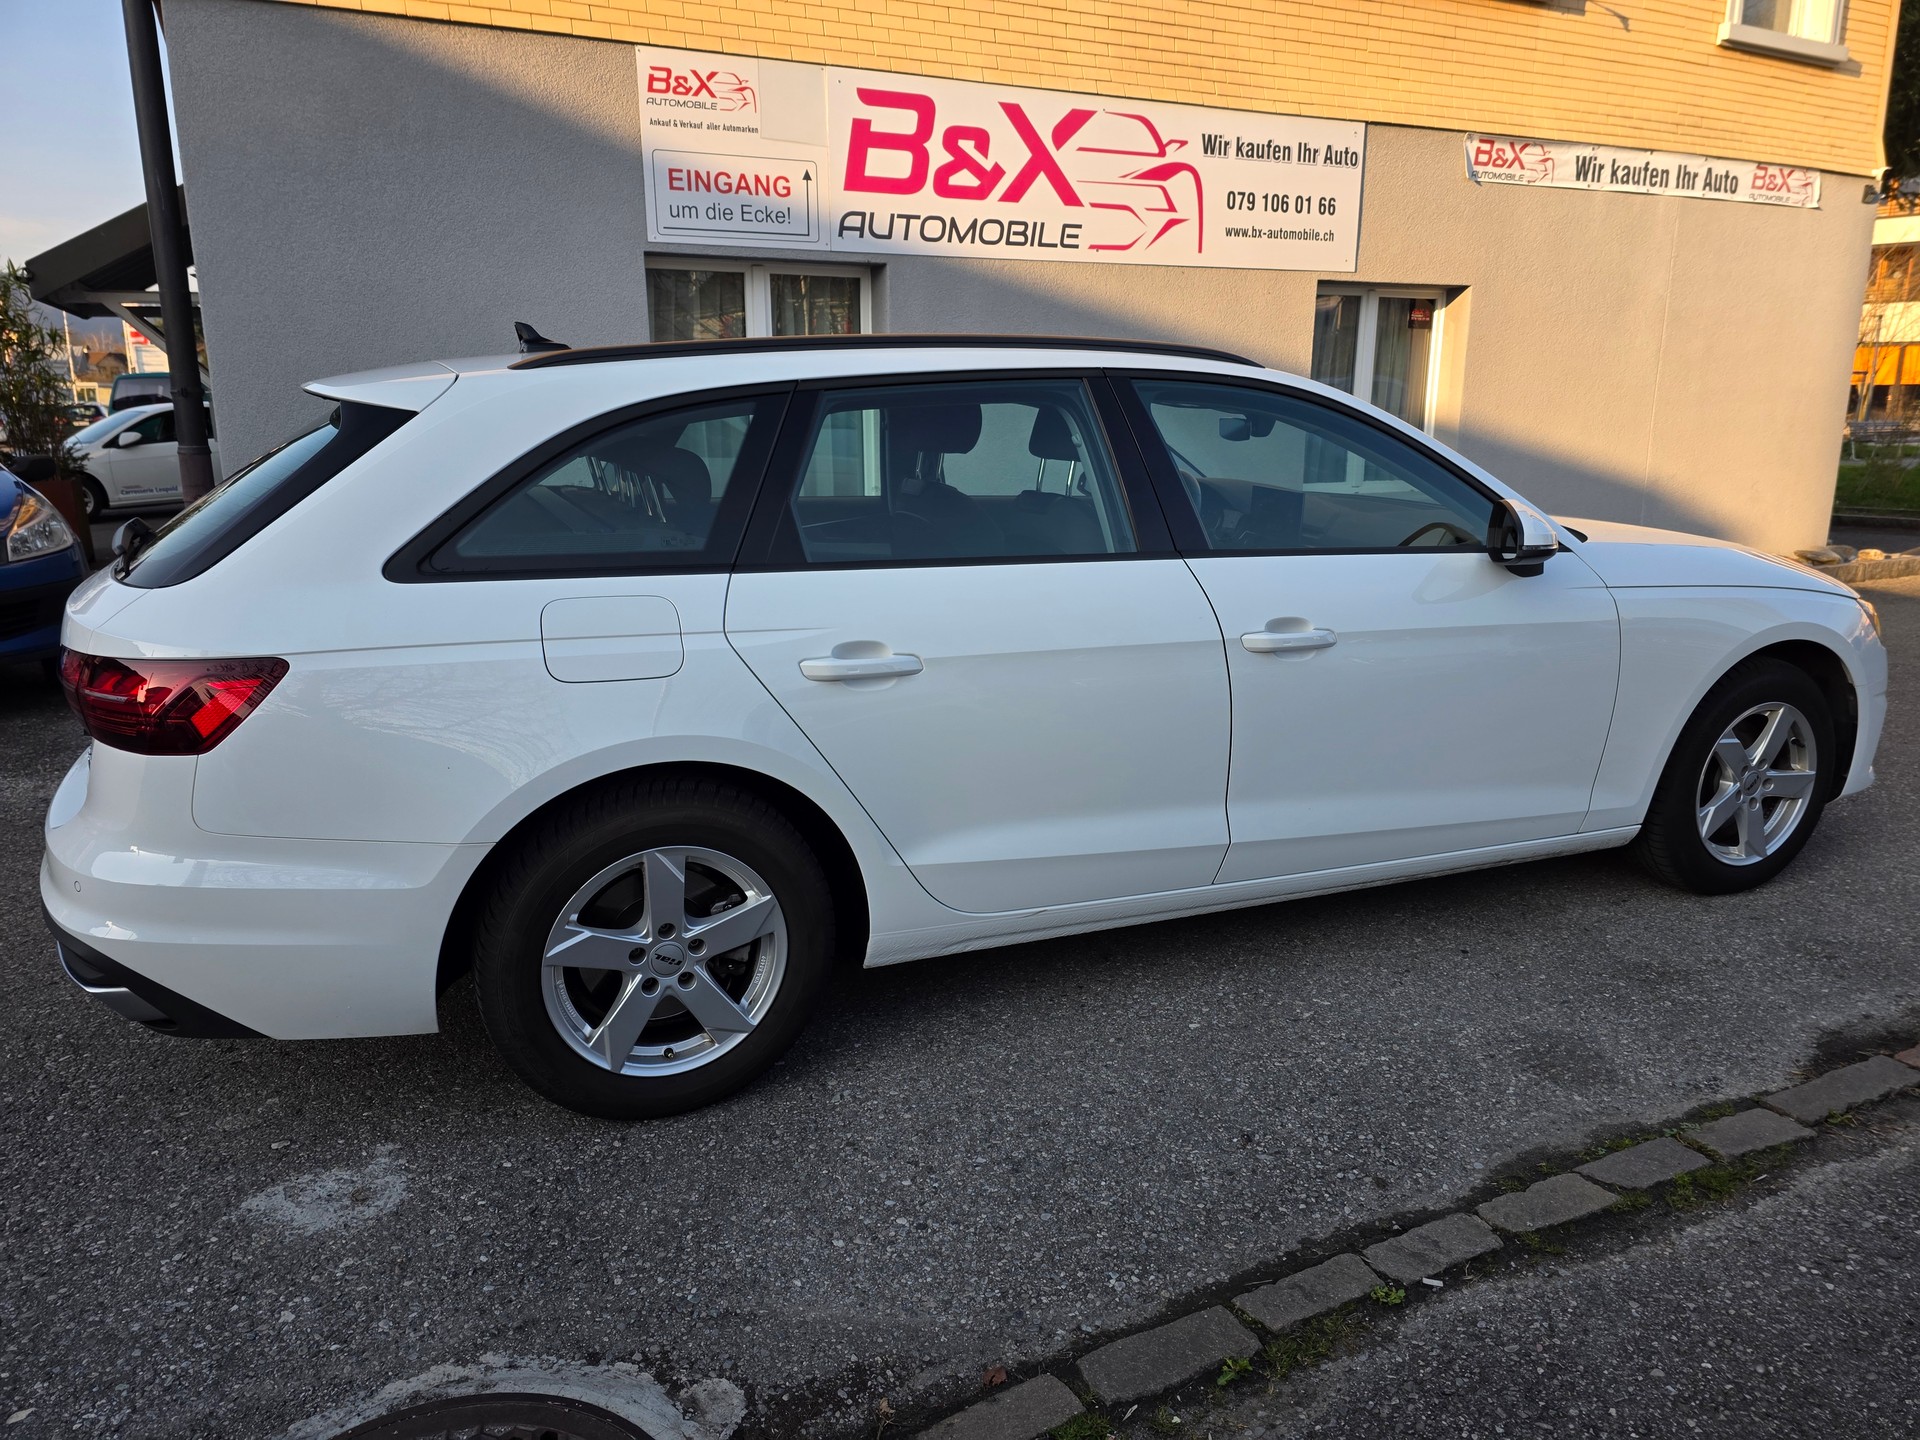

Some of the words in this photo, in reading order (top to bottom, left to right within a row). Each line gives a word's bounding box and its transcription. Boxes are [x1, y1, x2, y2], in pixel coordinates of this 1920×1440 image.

[647, 66, 719, 98] B&X
[646, 97, 717, 110] AUTOMOBILE
[650, 118, 671, 127] Ankauf
[680, 120, 703, 129] Verkauf
[706, 122, 720, 131] aller
[722, 123, 759, 133] Automarken
[843, 87, 1098, 207] B&X
[1202, 133, 1230, 157] Wir
[1235, 136, 1291, 162] kaufen
[1297, 142, 1319, 164] Ihr
[1323, 144, 1358, 167] Auto
[1473, 138, 1531, 170] B&X
[668, 167, 791, 198] EINGANG
[1471, 169, 1525, 182] AUTOMOBILE
[1575, 155, 1605, 183] Wir
[1610, 158, 1670, 188] kaufen
[1675, 164, 1699, 191] Ihr
[1702, 167, 1739, 195] Auto
[1751, 163, 1796, 193] B&X
[669, 204, 699, 219] um
[705, 202, 734, 221] die
[740, 203, 791, 224] Ecke!
[1226, 190, 1256, 211] 079
[1262, 192, 1290, 213] 106
[1294, 195, 1312, 214] 01
[1318, 197, 1337, 216] 66
[1748, 192, 1791, 204] AUTOMOBILE
[838, 210, 1083, 249] AUTOMOBILE
[1225, 225, 1335, 242] www.bx-automobile.ch
